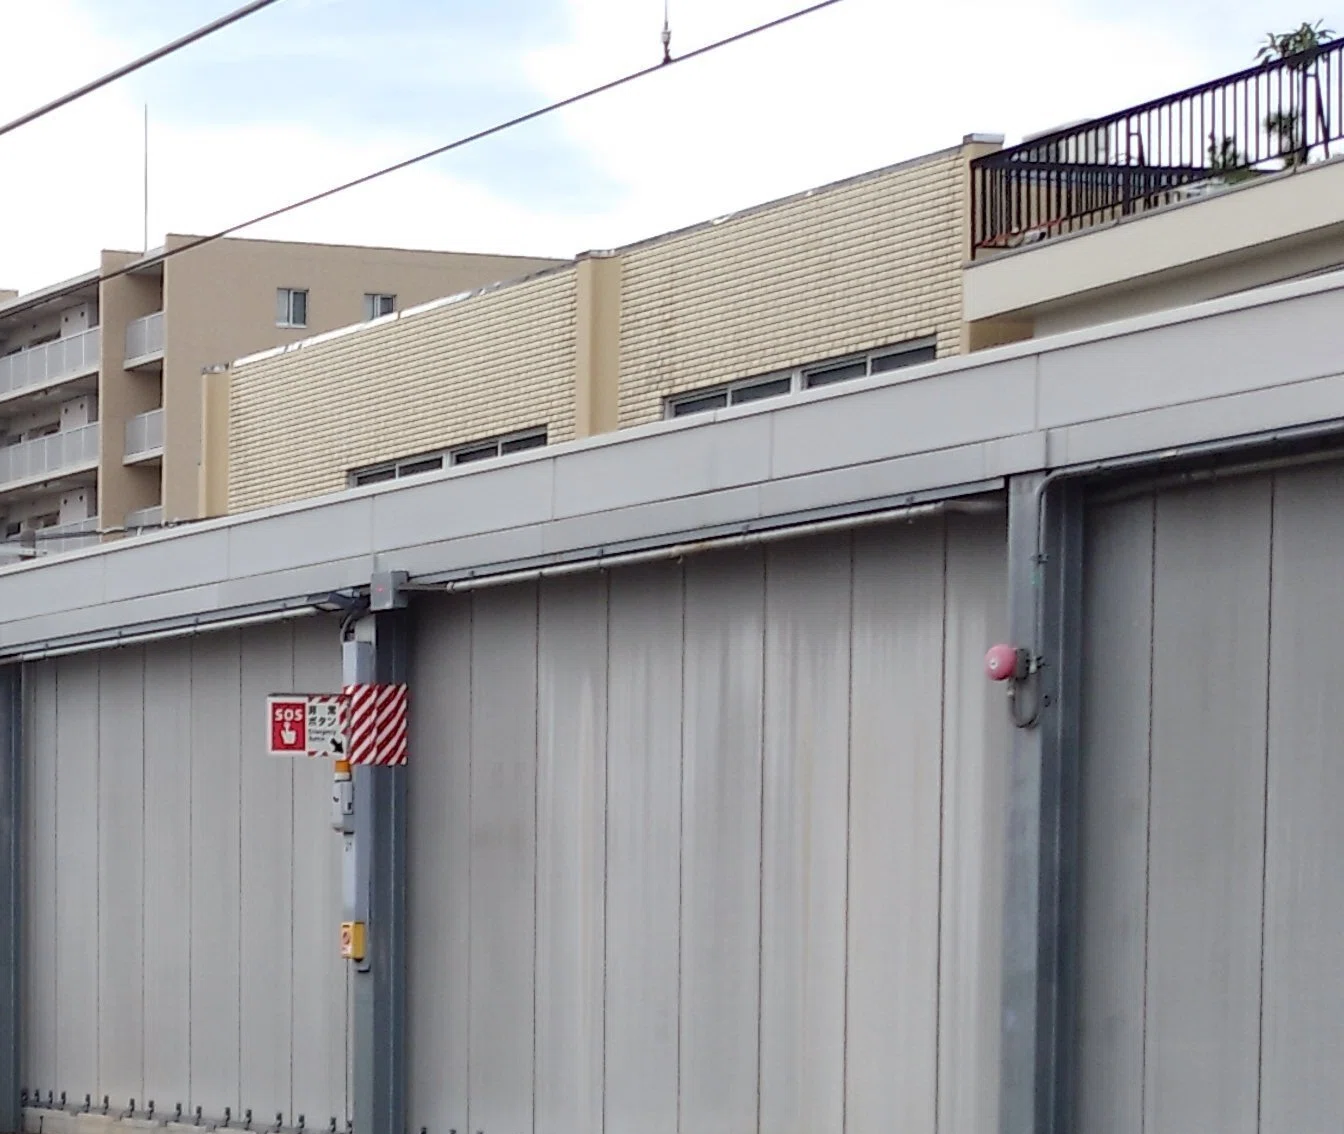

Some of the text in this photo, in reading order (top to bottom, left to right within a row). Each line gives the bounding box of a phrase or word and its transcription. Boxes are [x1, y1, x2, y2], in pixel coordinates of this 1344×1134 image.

[274, 708, 303, 722] SOS
[308, 716, 337, 727] ボタン
